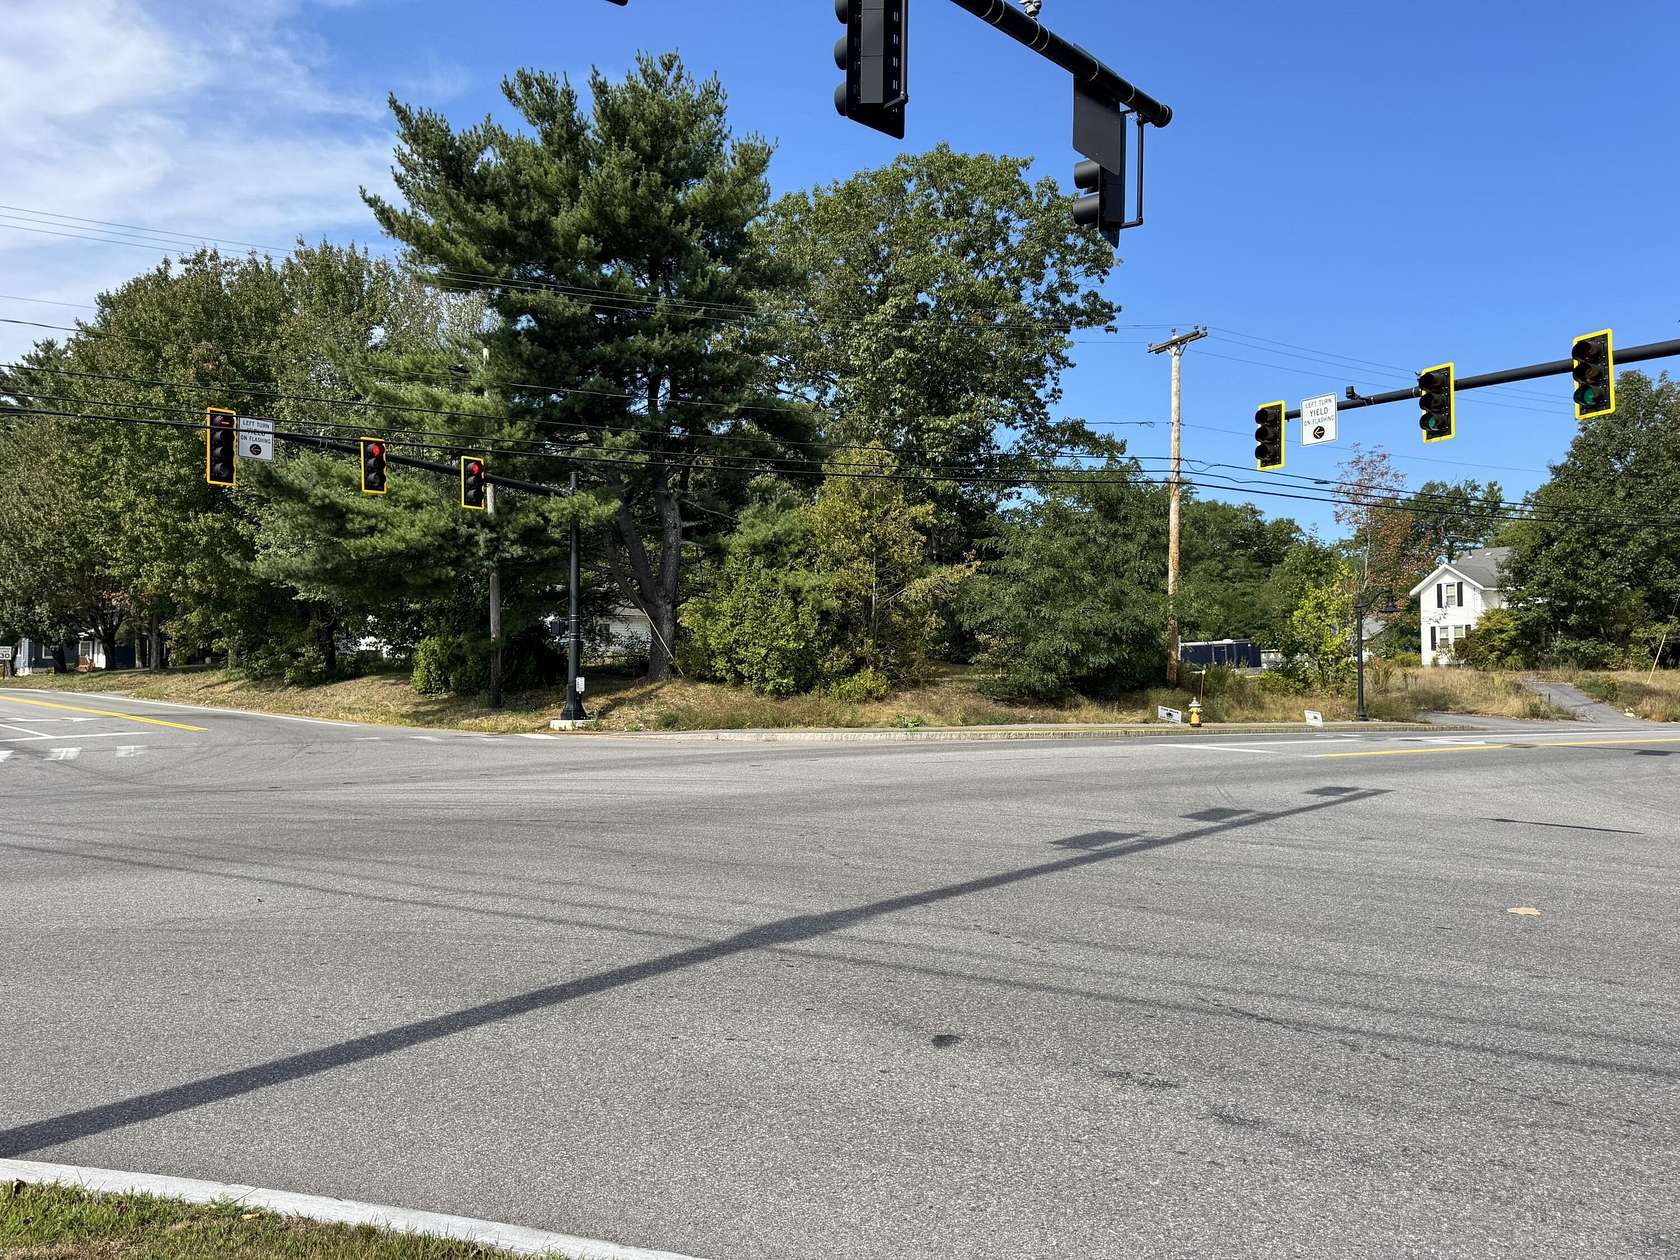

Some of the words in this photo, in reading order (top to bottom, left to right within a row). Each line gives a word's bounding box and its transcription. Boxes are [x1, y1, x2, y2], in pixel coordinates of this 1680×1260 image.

[1305, 400, 1316, 408] LEFT
[1310, 407, 1328, 416] YIELD
[1312, 415, 1334, 424] FLASHING
[249, 436, 271, 444] FLASHING
